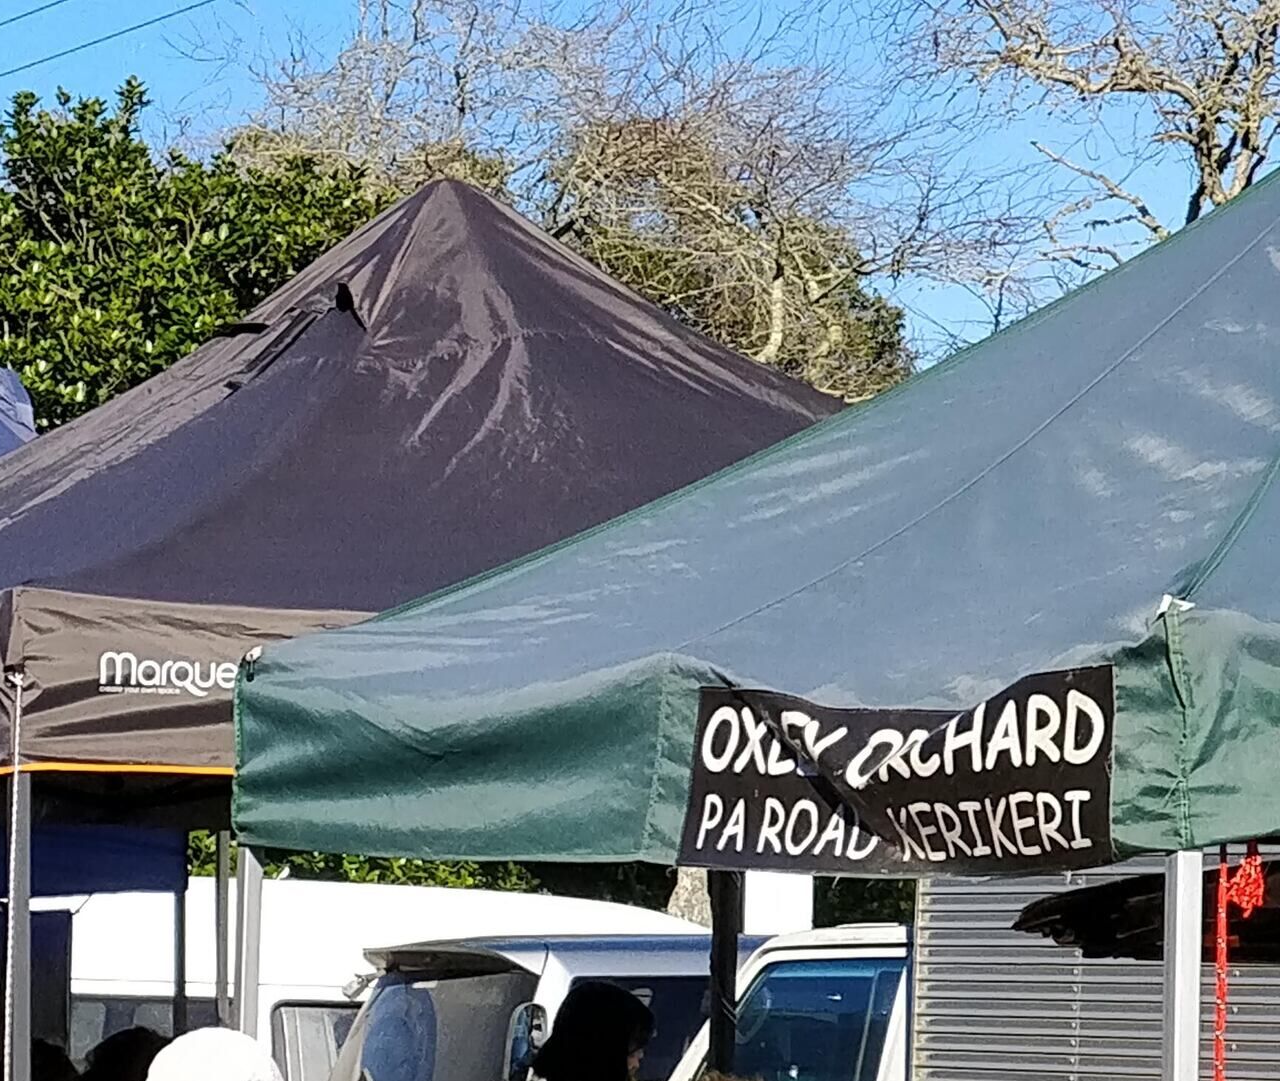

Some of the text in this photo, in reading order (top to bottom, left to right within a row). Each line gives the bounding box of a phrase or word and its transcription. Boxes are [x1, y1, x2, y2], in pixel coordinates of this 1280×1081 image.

[846, 689, 1106, 790] ORCHARD
[696, 789, 1094, 863] PA ROAD KERIKERI
